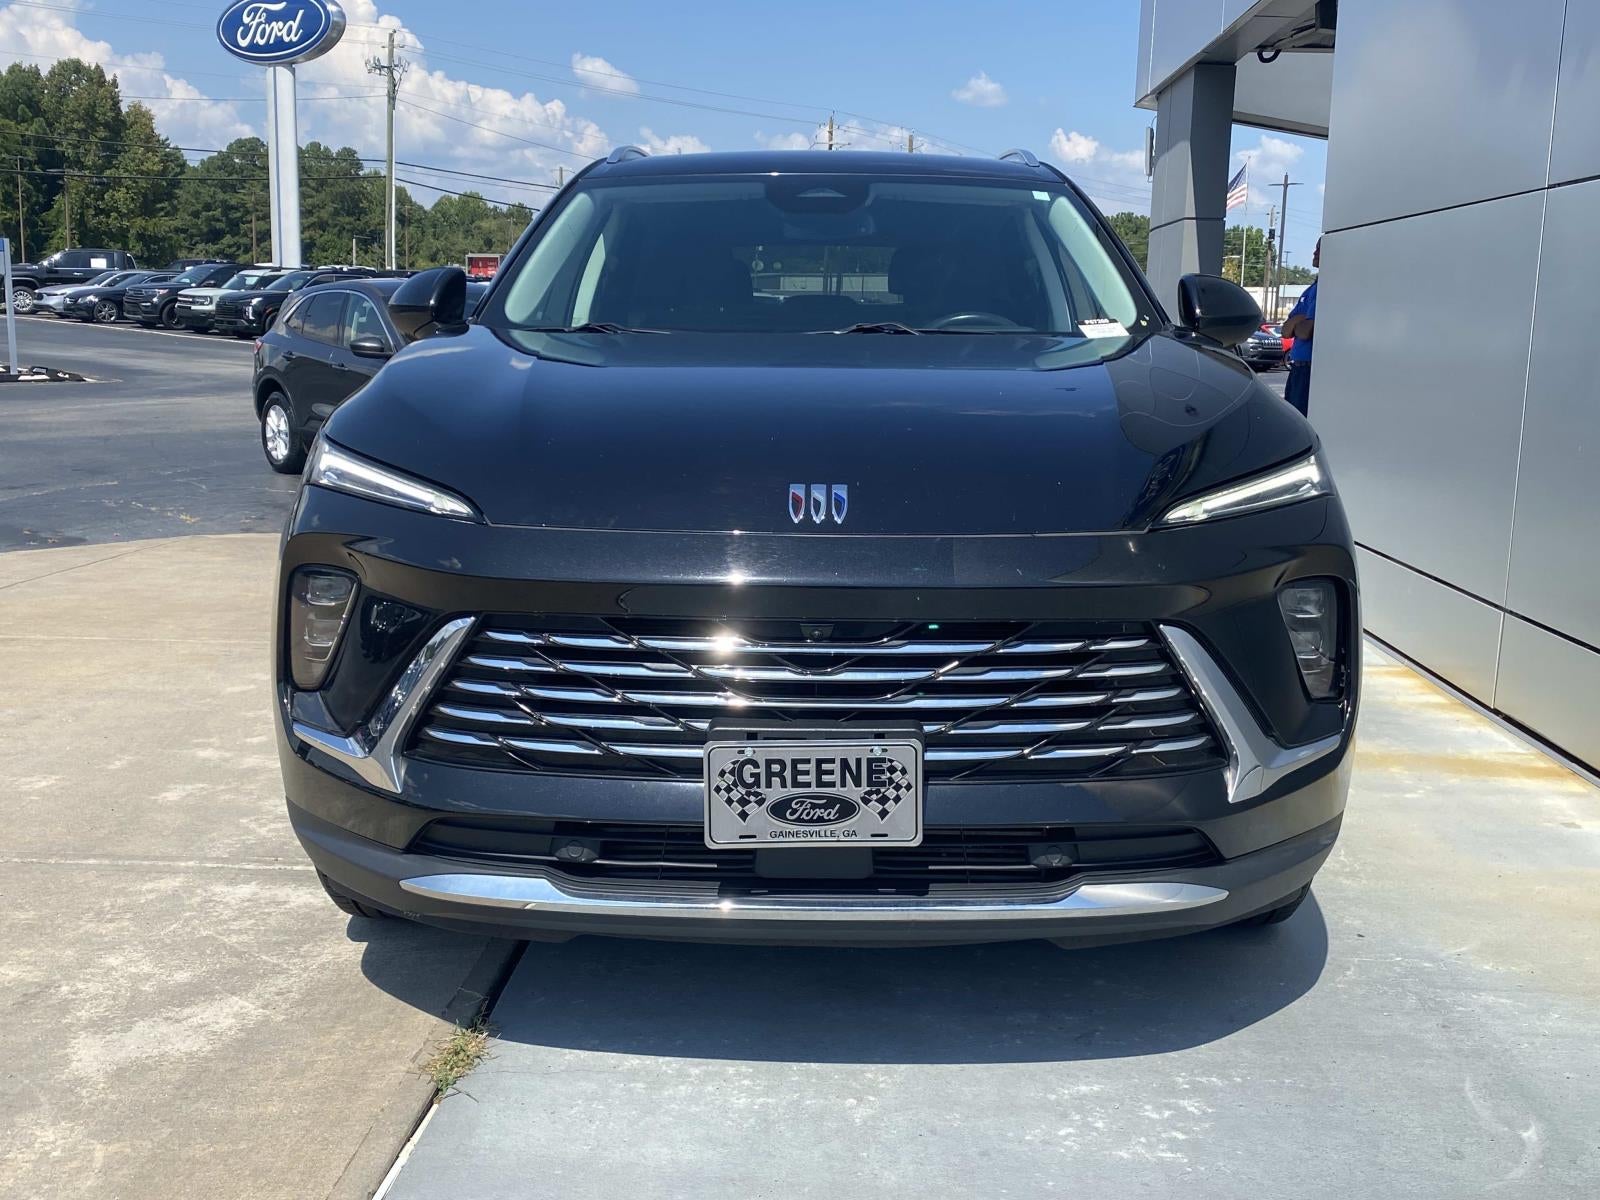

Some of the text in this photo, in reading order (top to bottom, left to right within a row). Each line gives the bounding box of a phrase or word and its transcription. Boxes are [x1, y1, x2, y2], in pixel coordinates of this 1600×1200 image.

[237, 1, 304, 47] Ford
[736, 757, 889, 789] GREENE
[786, 798, 839, 821] Ford
[769, 829, 857, 839] GAINESVILLE, GA
